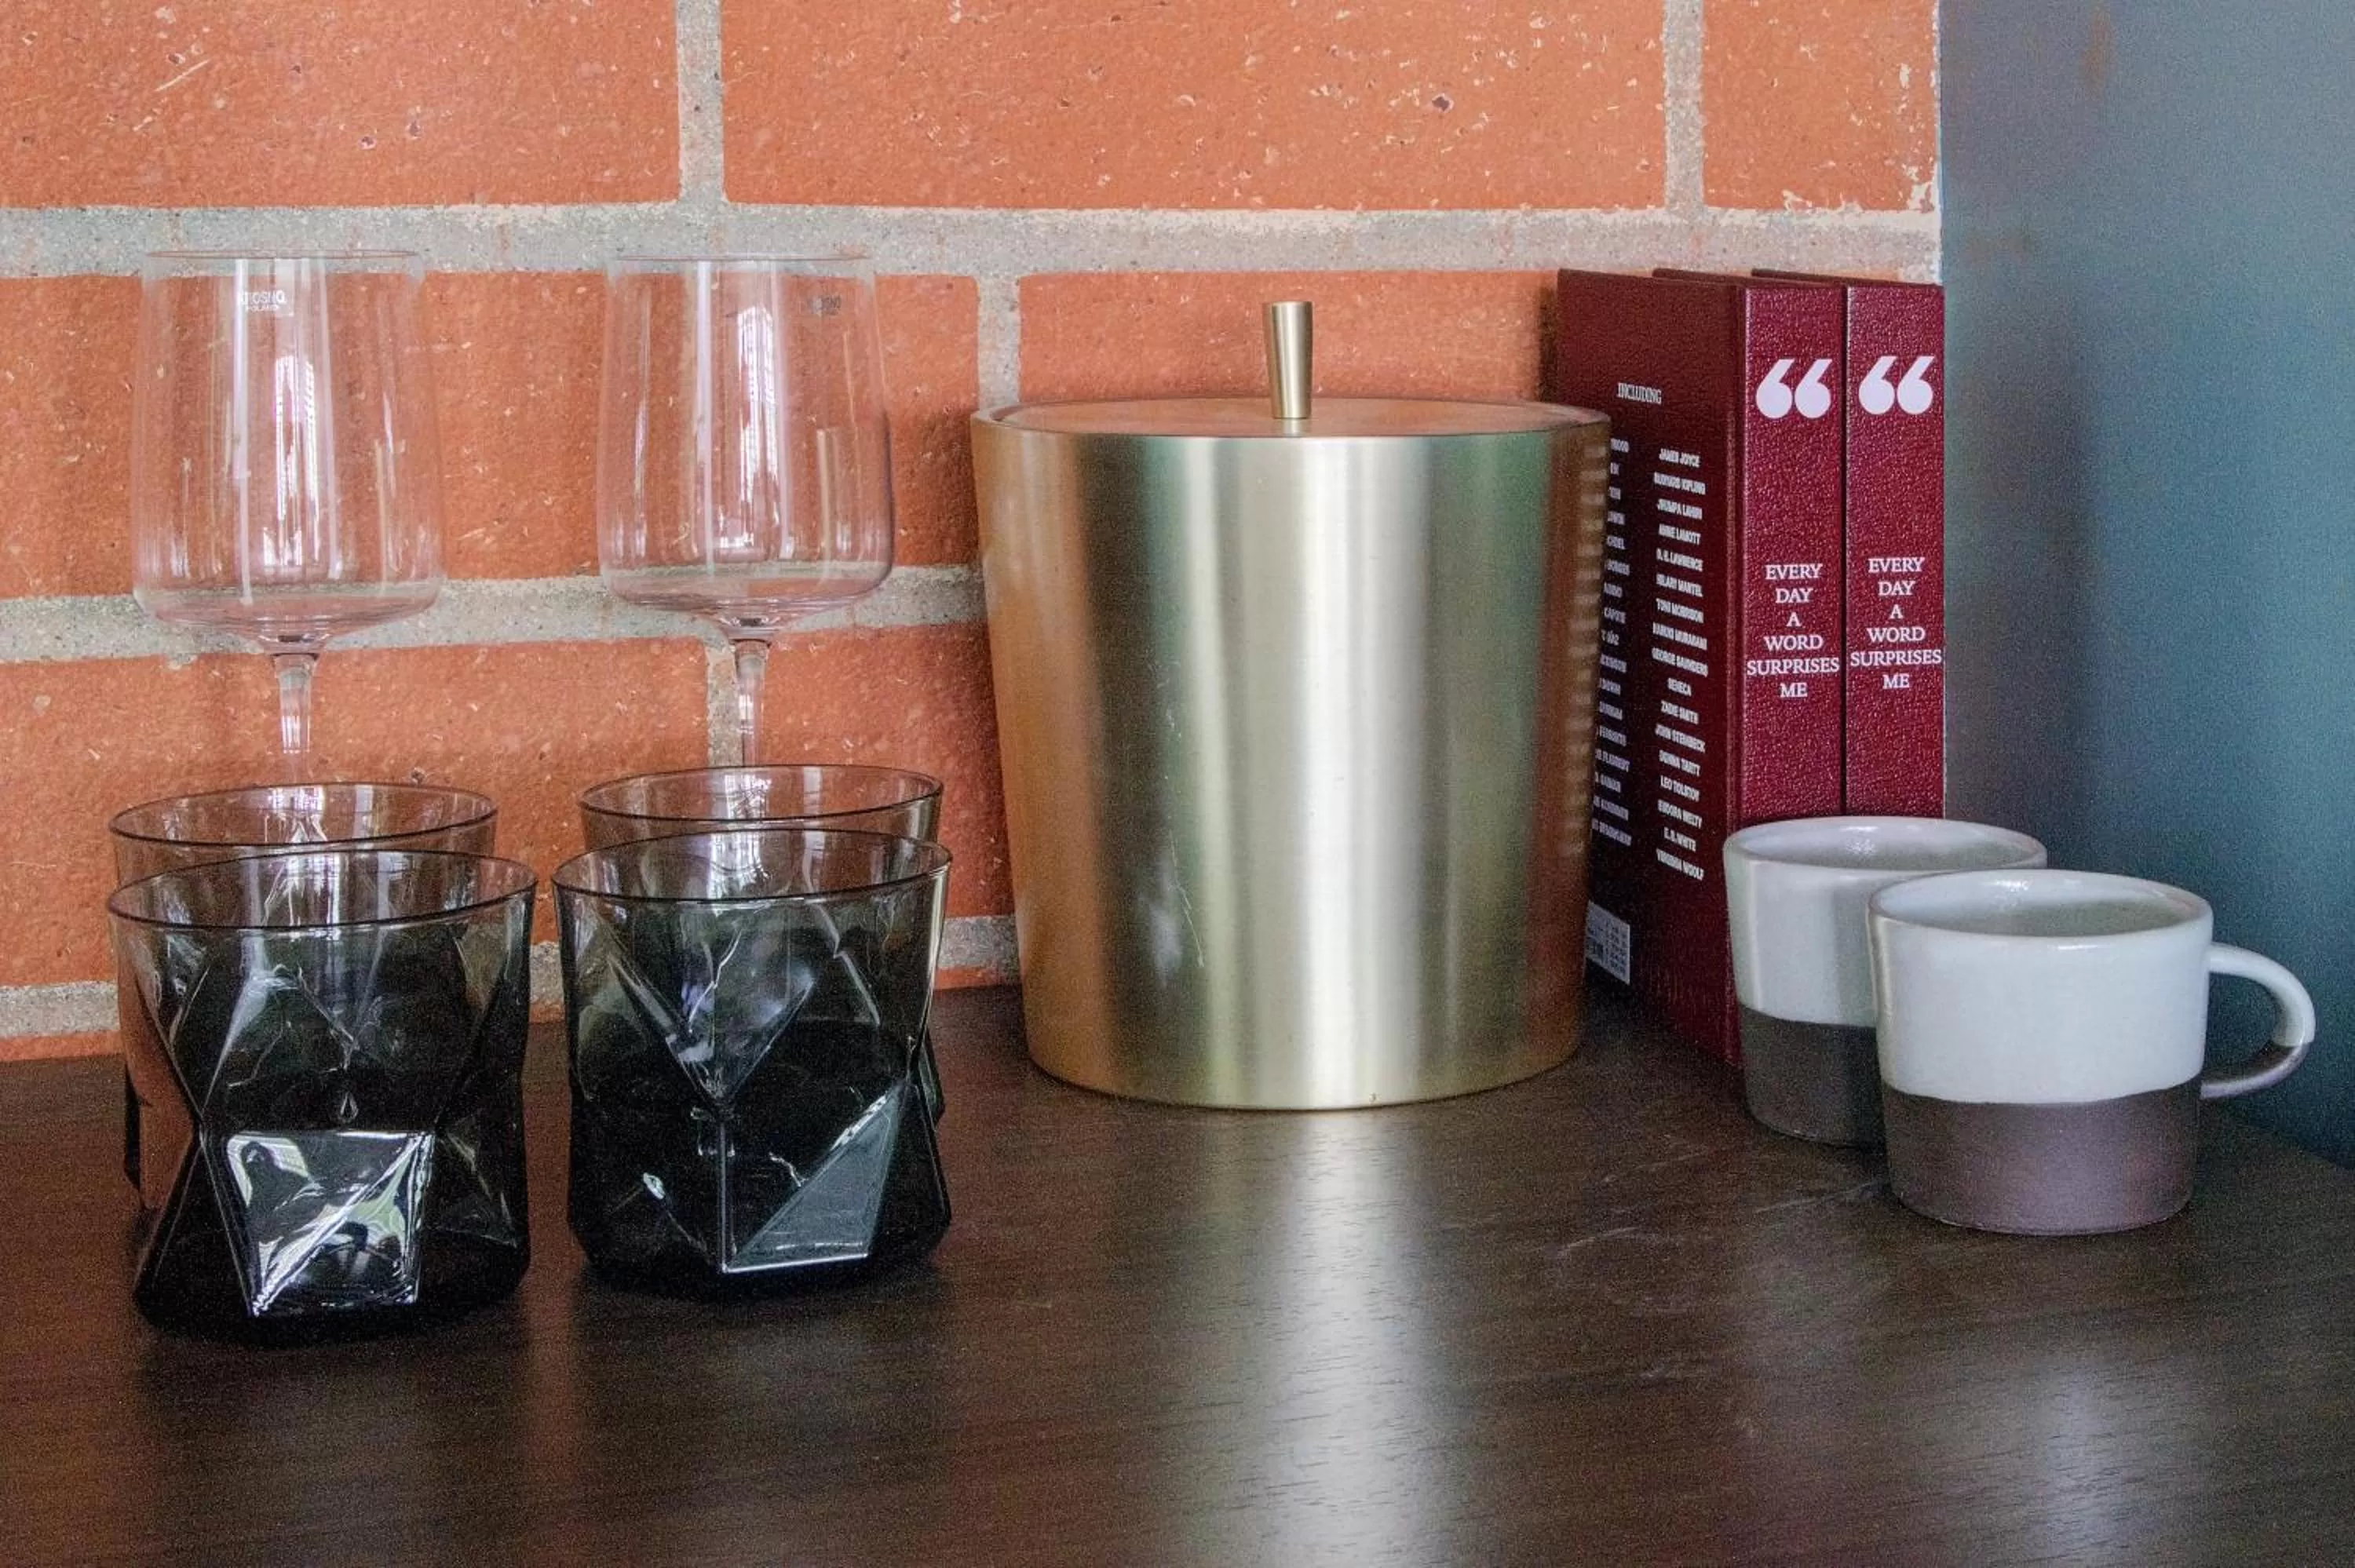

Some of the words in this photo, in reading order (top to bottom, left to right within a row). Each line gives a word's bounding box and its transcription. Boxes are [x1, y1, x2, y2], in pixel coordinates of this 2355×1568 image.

[1616, 382, 1662, 405] INCLUDING
[1765, 563, 1823, 580] EVERY
[1868, 557, 1925, 573] EVERY
[1775, 588, 1813, 603] DAY
[1878, 580, 1915, 596] DAY
[1889, 604, 1904, 619] A
[1786, 612, 1802, 627] A
[1867, 627, 1926, 642] WORD
[1764, 635, 1824, 651] WORD
[1850, 649, 1943, 666] SURPRISES
[1747, 657, 1840, 676] SURPRISES
[1882, 674, 1910, 689] ME
[1780, 683, 1808, 697] ME
[1660, 775, 1673, 790] LEO
